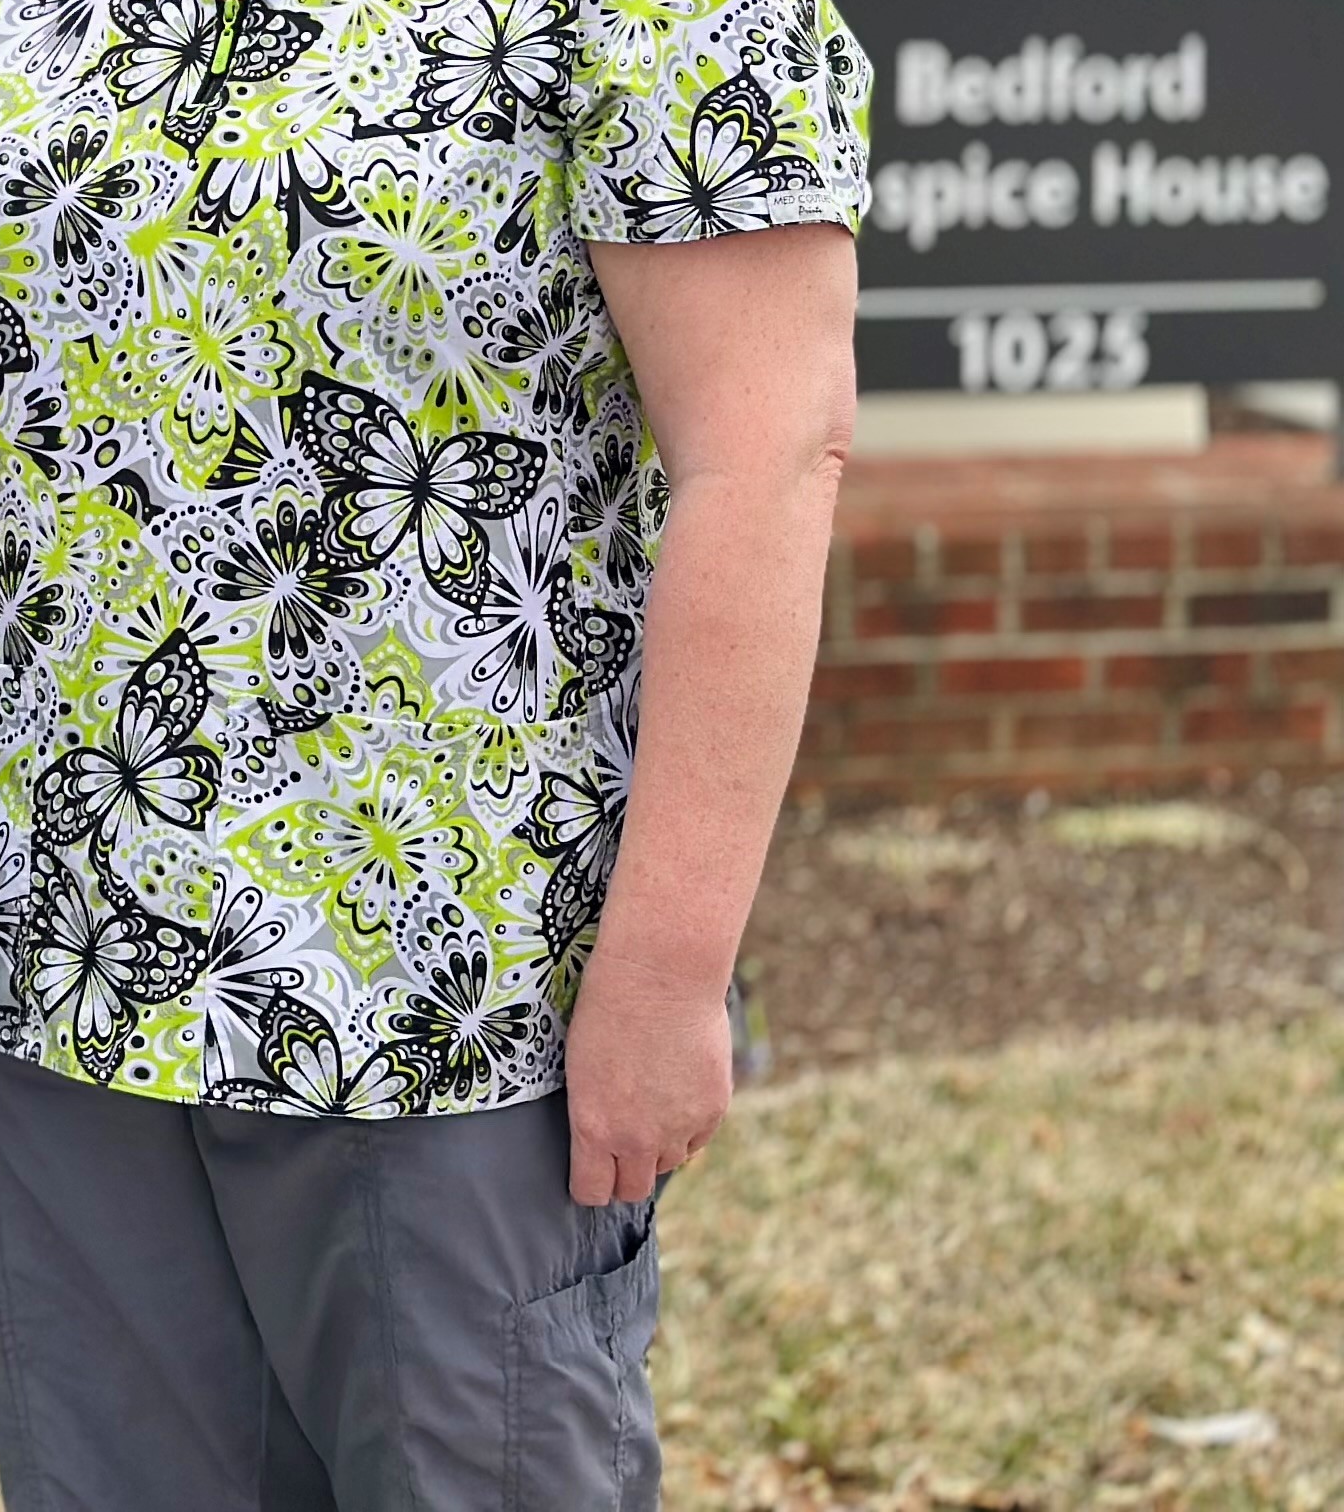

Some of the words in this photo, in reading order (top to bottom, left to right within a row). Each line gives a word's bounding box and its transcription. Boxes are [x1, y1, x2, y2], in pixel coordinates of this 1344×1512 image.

[896, 31, 1207, 126] Bedford
[773, 195, 795, 205] MED
[871, 141, 1081, 253] spice
[1090, 140, 1330, 228] House
[949, 305, 1150, 392] 1025
